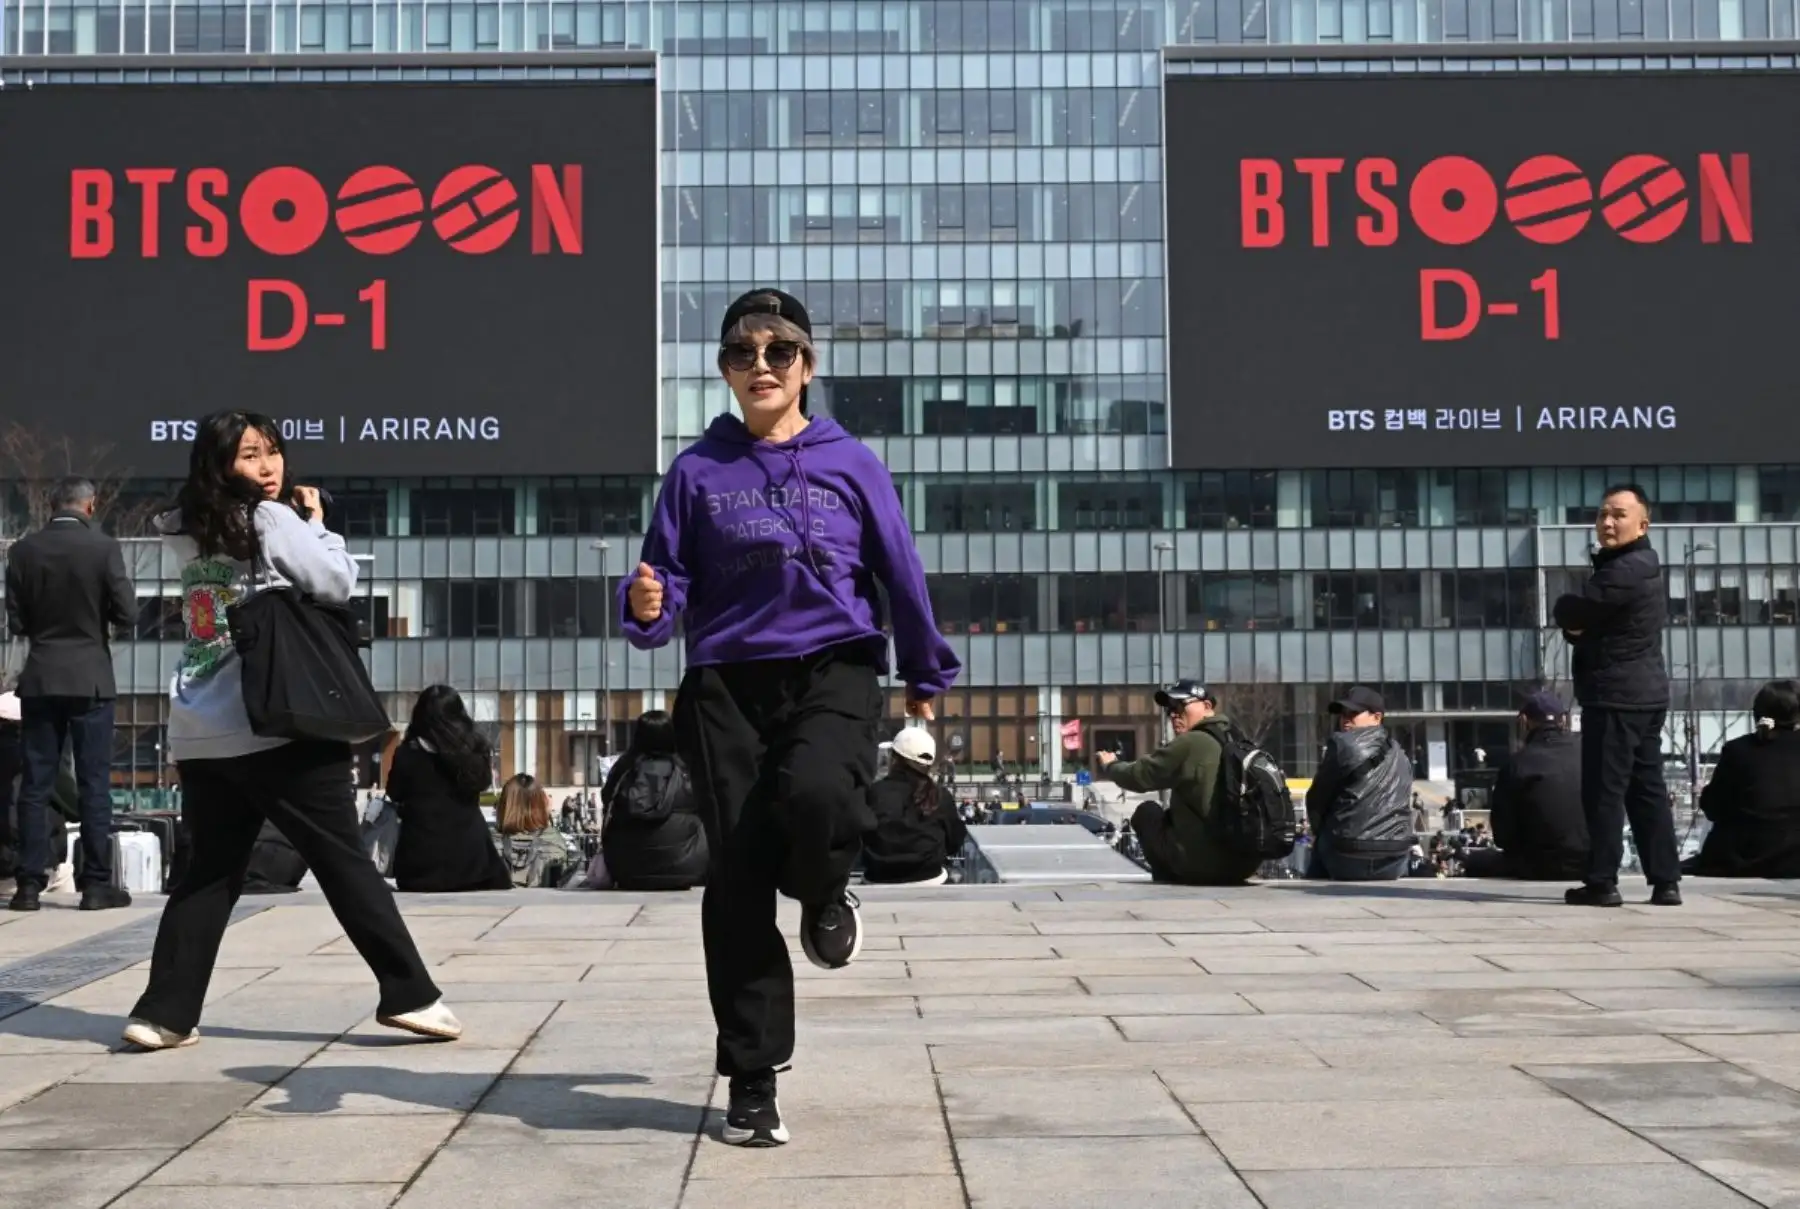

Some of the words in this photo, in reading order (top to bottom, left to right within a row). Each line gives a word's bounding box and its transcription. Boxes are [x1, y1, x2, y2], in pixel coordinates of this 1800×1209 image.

[246, 278, 387, 352] D-1
[1419, 268, 1559, 341] D-1
[150, 420, 197, 442] BTS
[273, 418, 325, 441] 이브
[359, 417, 500, 441] ARIRANG
[1328, 409, 1375, 431] BTS
[1384, 408, 1427, 431] 컴백
[1435, 408, 1502, 430] 라이브
[1536, 405, 1677, 430] ARIRANG
[707, 487, 840, 516] STANDARD
